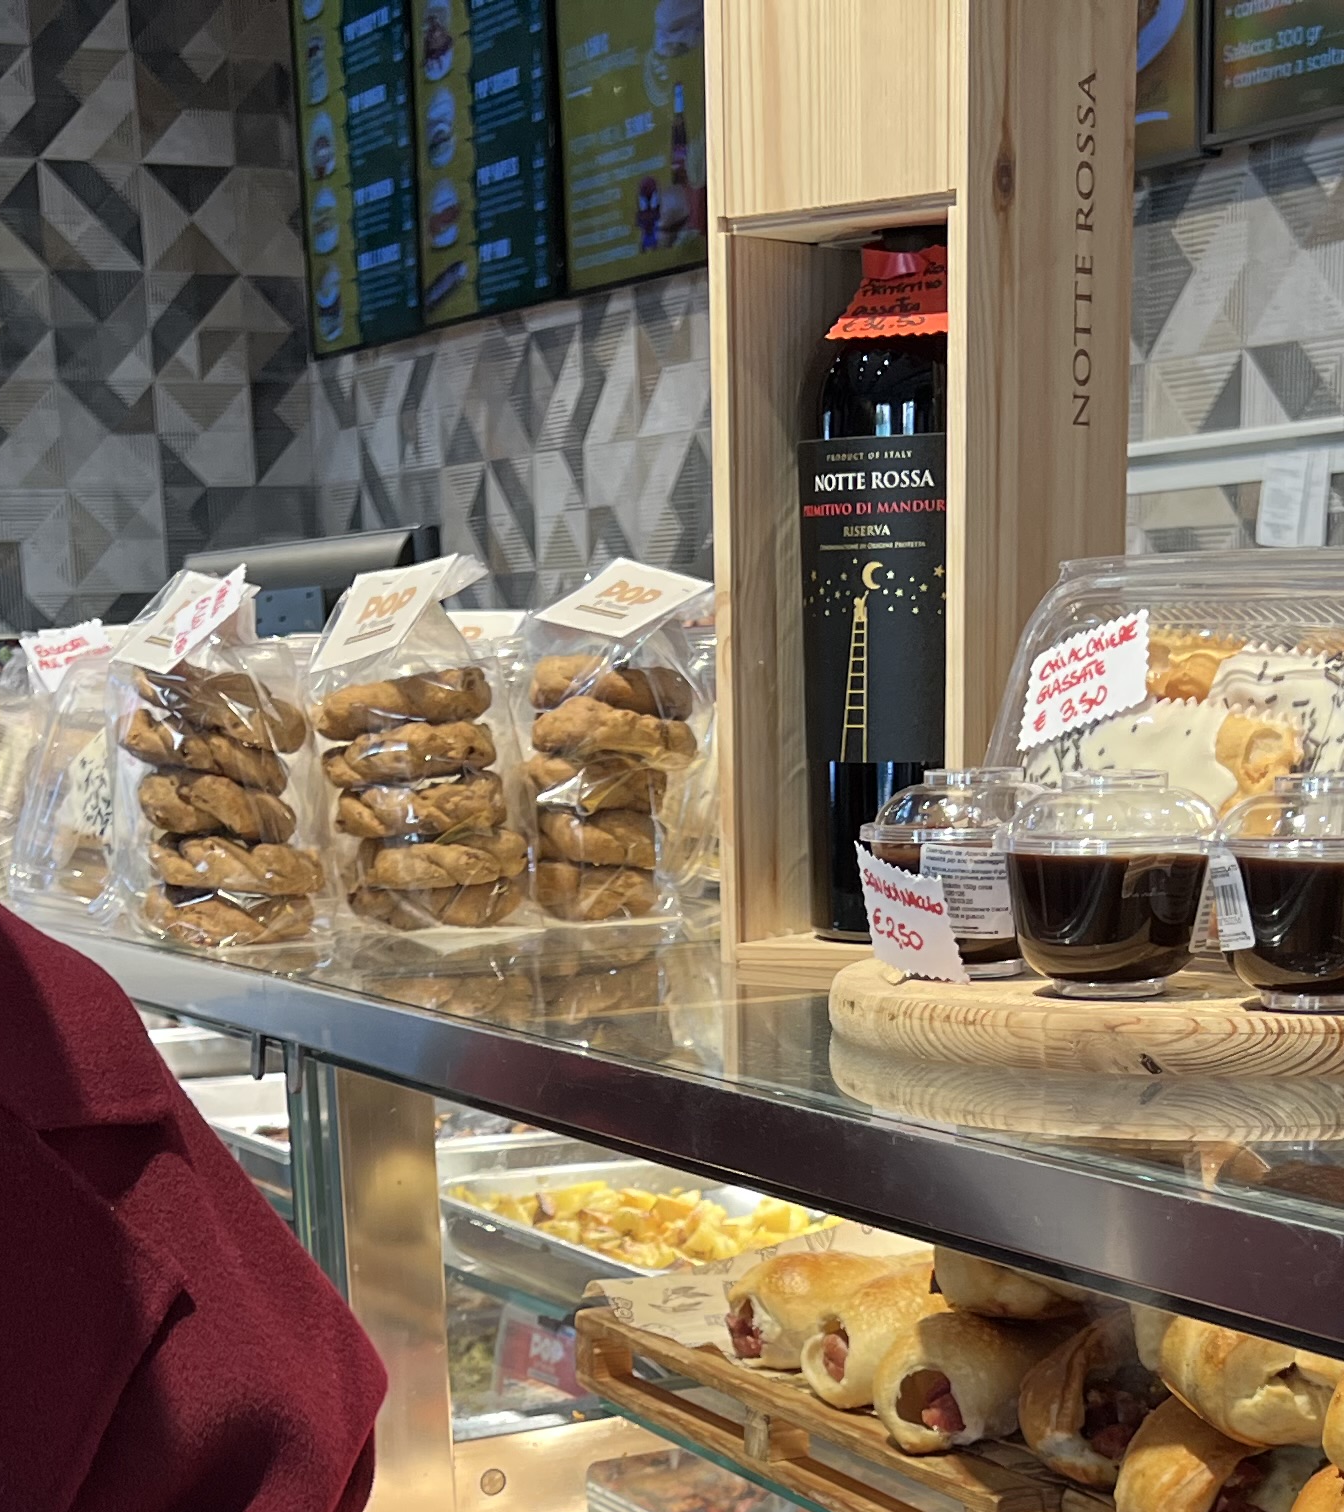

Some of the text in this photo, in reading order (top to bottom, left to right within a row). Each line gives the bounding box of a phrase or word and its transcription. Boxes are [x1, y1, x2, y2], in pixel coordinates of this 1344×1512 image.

[1072, 72, 1098, 427] NOTTE ROSSA
[884, 450, 912, 459] ITALY
[814, 469, 935, 492] NOTTE ROSSA
[856, 502, 872, 514] DI
[876, 499, 946, 514] MANDUR
[843, 524, 891, 537] RISERVA
[596, 580, 663, 606] POP
[356, 586, 417, 625] POP
[1036, 659, 1105, 704] GLASSATE
[1033, 710, 1047, 732] €
